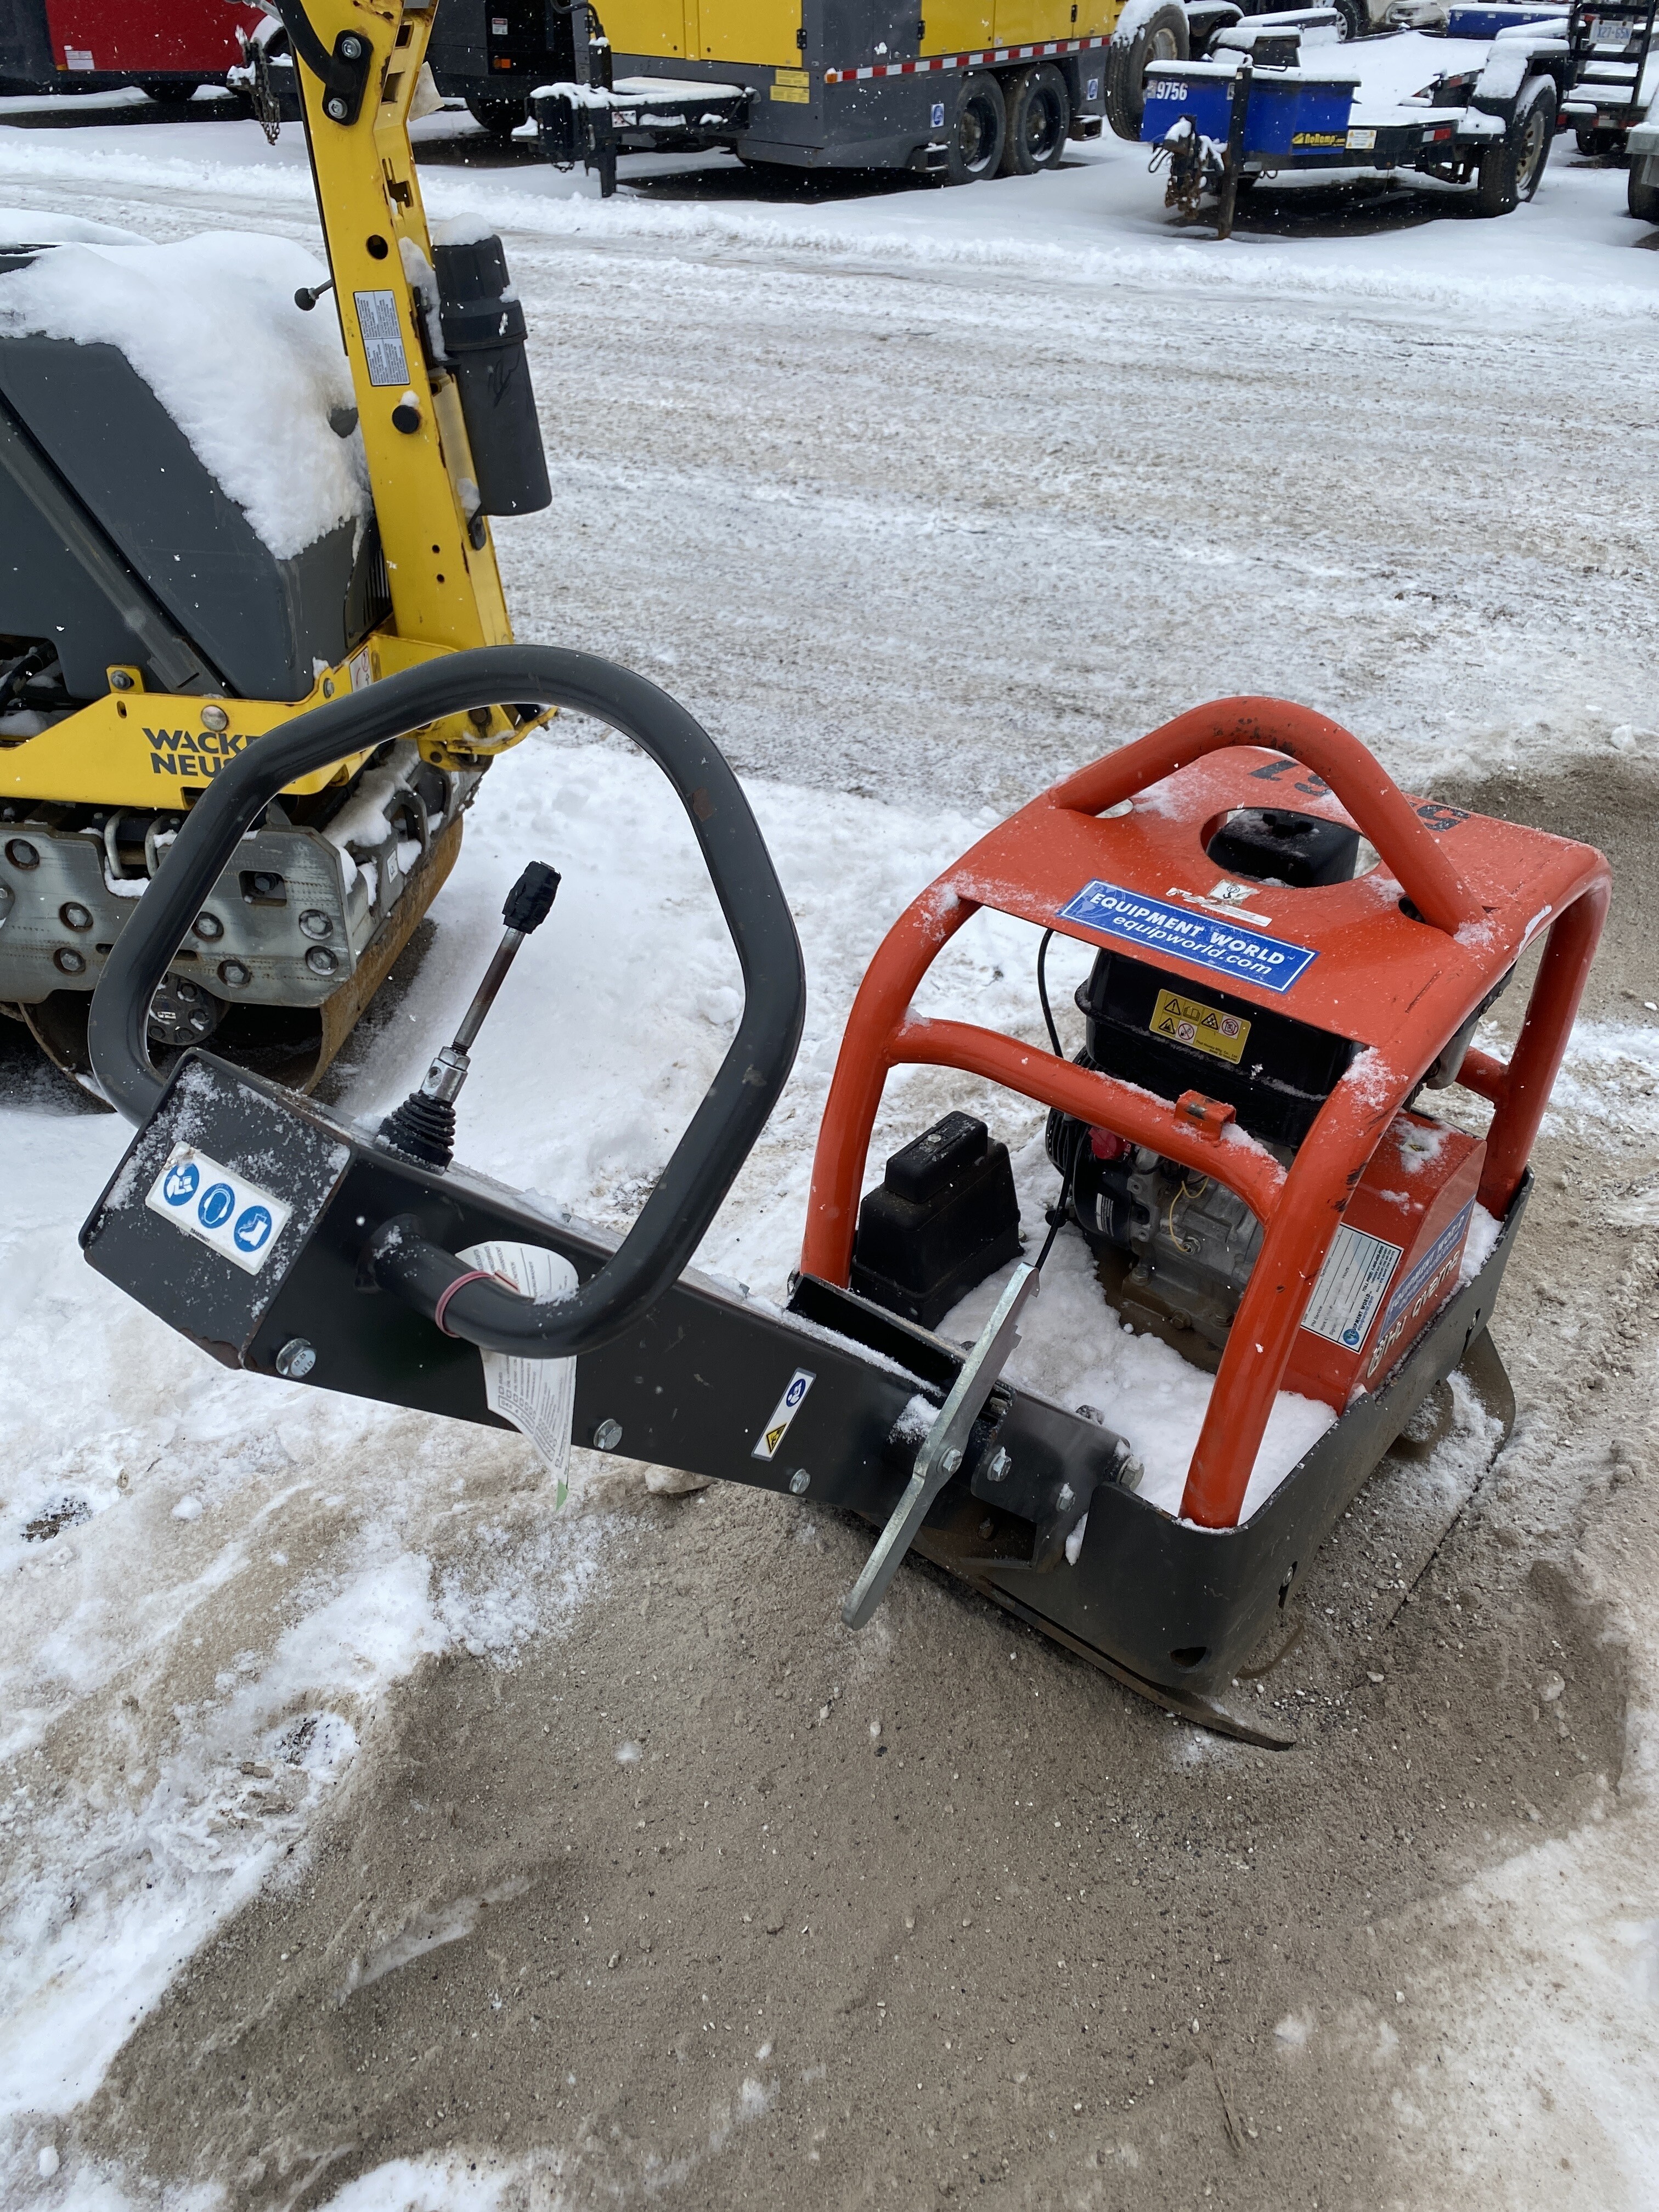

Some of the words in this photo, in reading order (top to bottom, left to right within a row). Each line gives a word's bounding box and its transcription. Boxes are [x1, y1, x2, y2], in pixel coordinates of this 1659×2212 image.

[142, 727, 262, 755] WACK
[150, 752, 233, 778] NEU
[1090, 893, 1205, 936] EQUIPMENT
[1209, 928, 1285, 965] WORLD
[1113, 915, 1272, 975] equipworld.com
[1349, 1311, 1363, 1336] EQUIPMENT
[1360, 1293, 1370, 1310] WORLD
